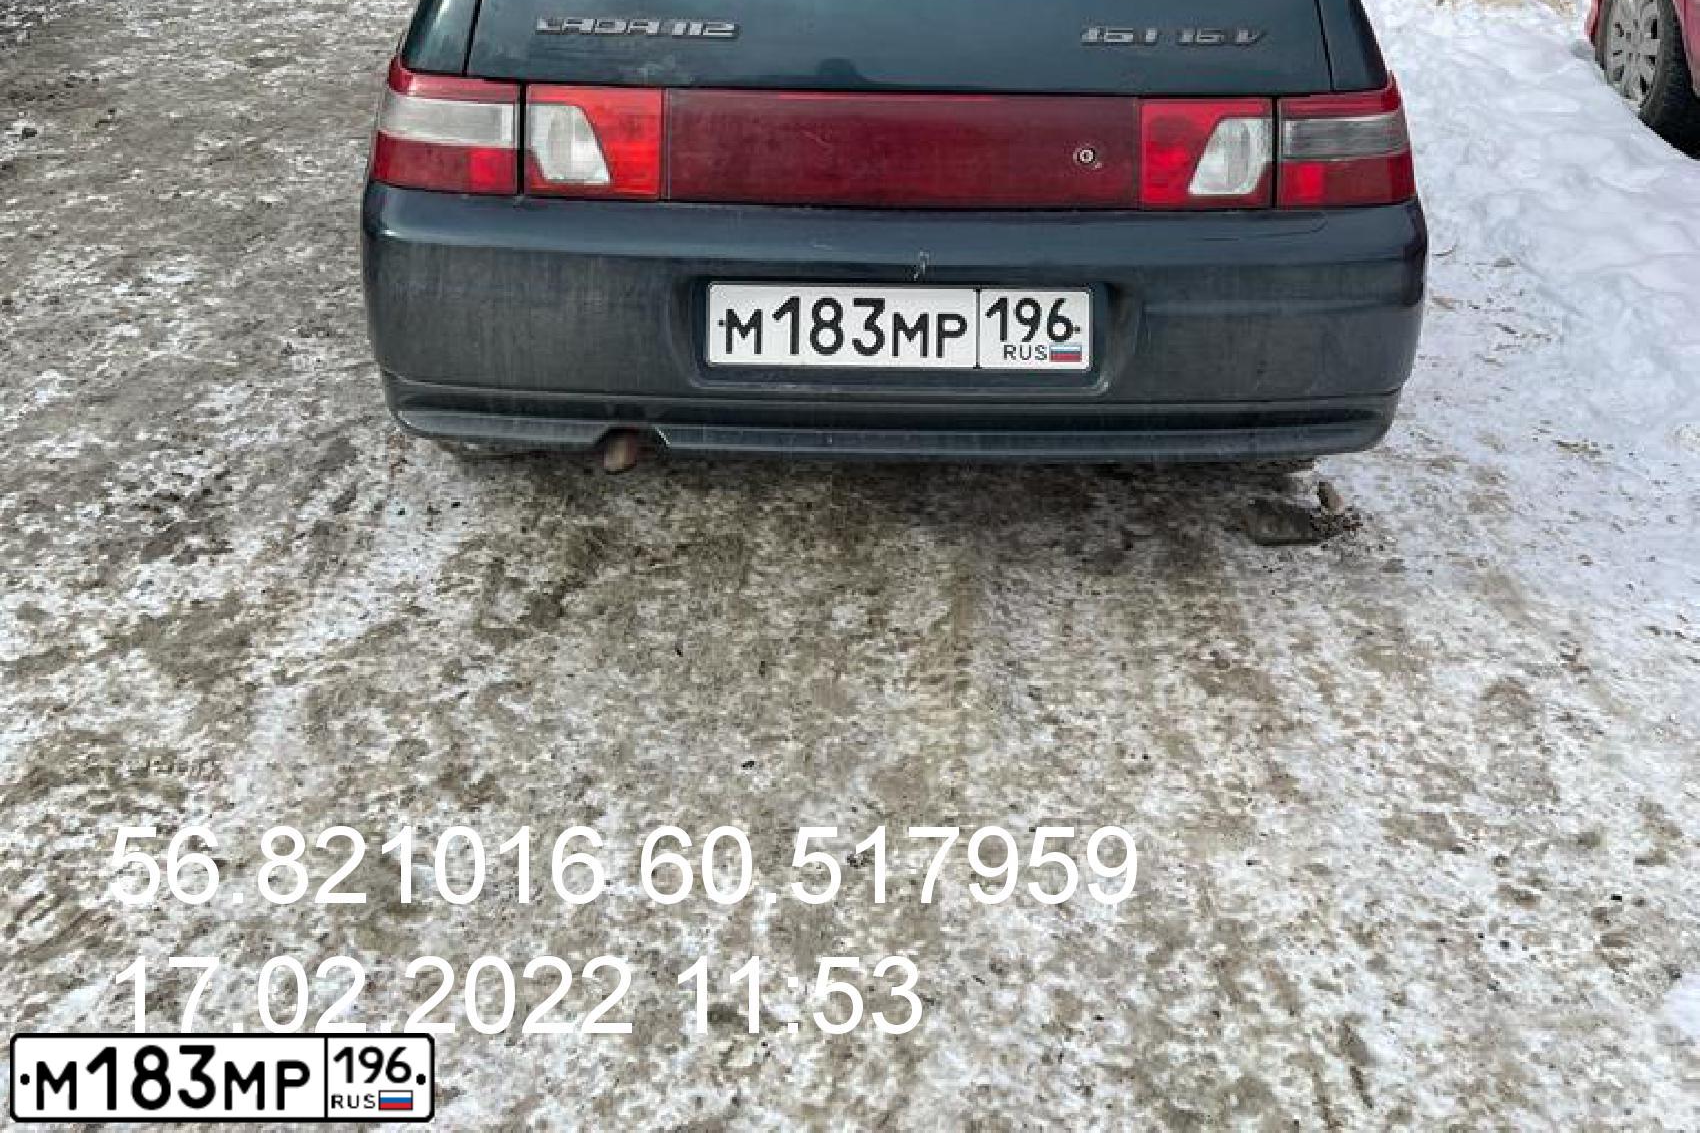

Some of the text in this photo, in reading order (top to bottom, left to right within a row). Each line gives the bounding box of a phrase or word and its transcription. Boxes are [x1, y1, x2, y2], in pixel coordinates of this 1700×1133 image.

[725, 296, 1074, 358] М183МР 196
[1003, 344, 1048, 361] RUS
